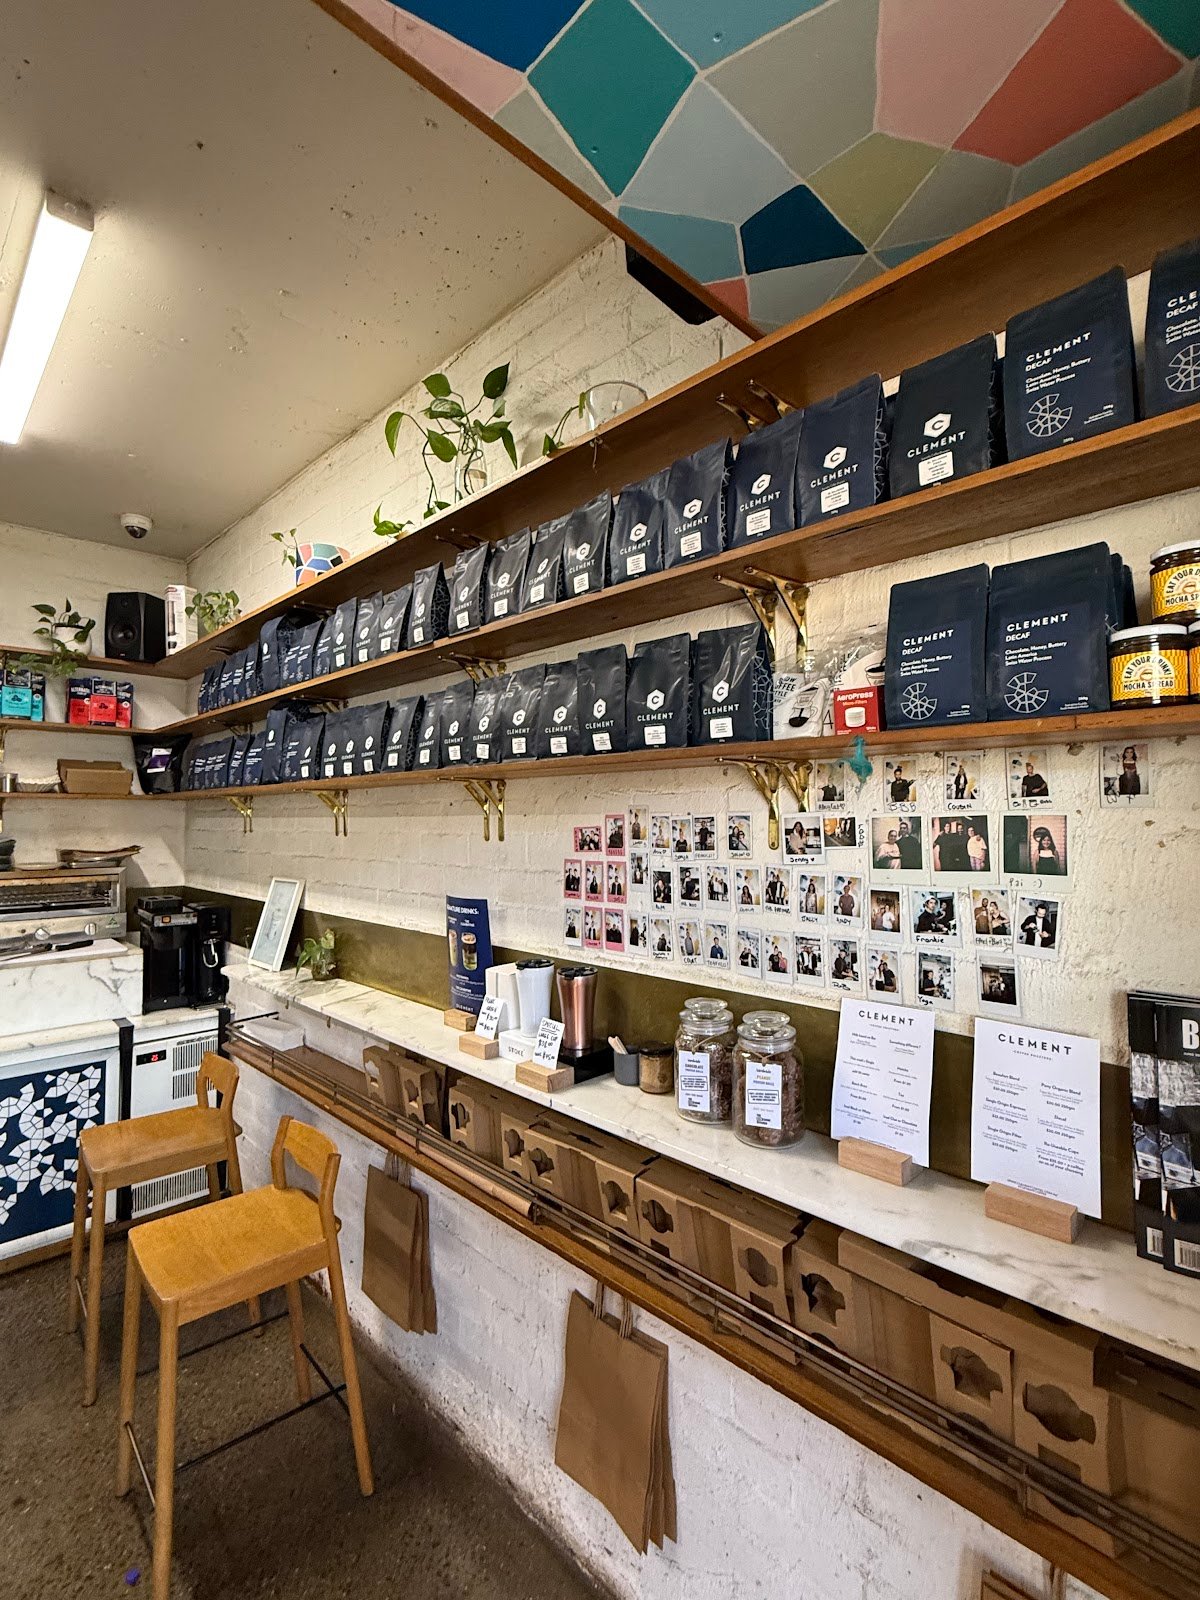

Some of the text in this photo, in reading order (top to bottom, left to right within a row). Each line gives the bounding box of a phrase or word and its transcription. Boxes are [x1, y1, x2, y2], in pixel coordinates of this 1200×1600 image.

[1166, 301, 1198, 318] DECAF
[1026, 332, 1091, 362] CLEMENT
[1025, 357, 1052, 372] DECAF
[907, 431, 966, 458] CLEMENT
[810, 463, 859, 489] CLEMENT
[739, 491, 781, 513] CLEMENT
[674, 515, 709, 535] CLEMENT
[619, 539, 652, 556] CLEMENT
[569, 560, 596, 575] CLEMENT
[1166, 568, 1194, 594] EAT YOUR
[490, 588, 514, 600] CLEMENT
[1165, 595, 1189, 606] MOCHA
[1006, 613, 1068, 632] CLEMENT
[903, 629, 954, 647] CLEMENT
[1005, 631, 1031, 643] DECAF
[902, 645, 923, 656] DECAF
[1048, 641, 1067, 649] Buttery
[1124, 667, 1135, 679] EAT
[1131, 656, 1151, 668] YOUR
[1123, 681, 1146, 691] MOCHA
[837, 691, 874, 702] AeroPress
[702, 703, 740, 716] CLEMENT
[637, 712, 674, 722] CLEMENT
[506, 727, 531, 736] CLEMENT
[544, 725, 573, 734] CLEMENT
[585, 719, 615, 730] CLEMENT
[443, 736, 464, 745] CLEMENT
[472, 733, 493, 741] CLEMENT
[915, 935, 945, 944] Frankie
[858, 1010, 915, 1026] CLEMENT
[998, 1033, 1072, 1055] CLEMENT
